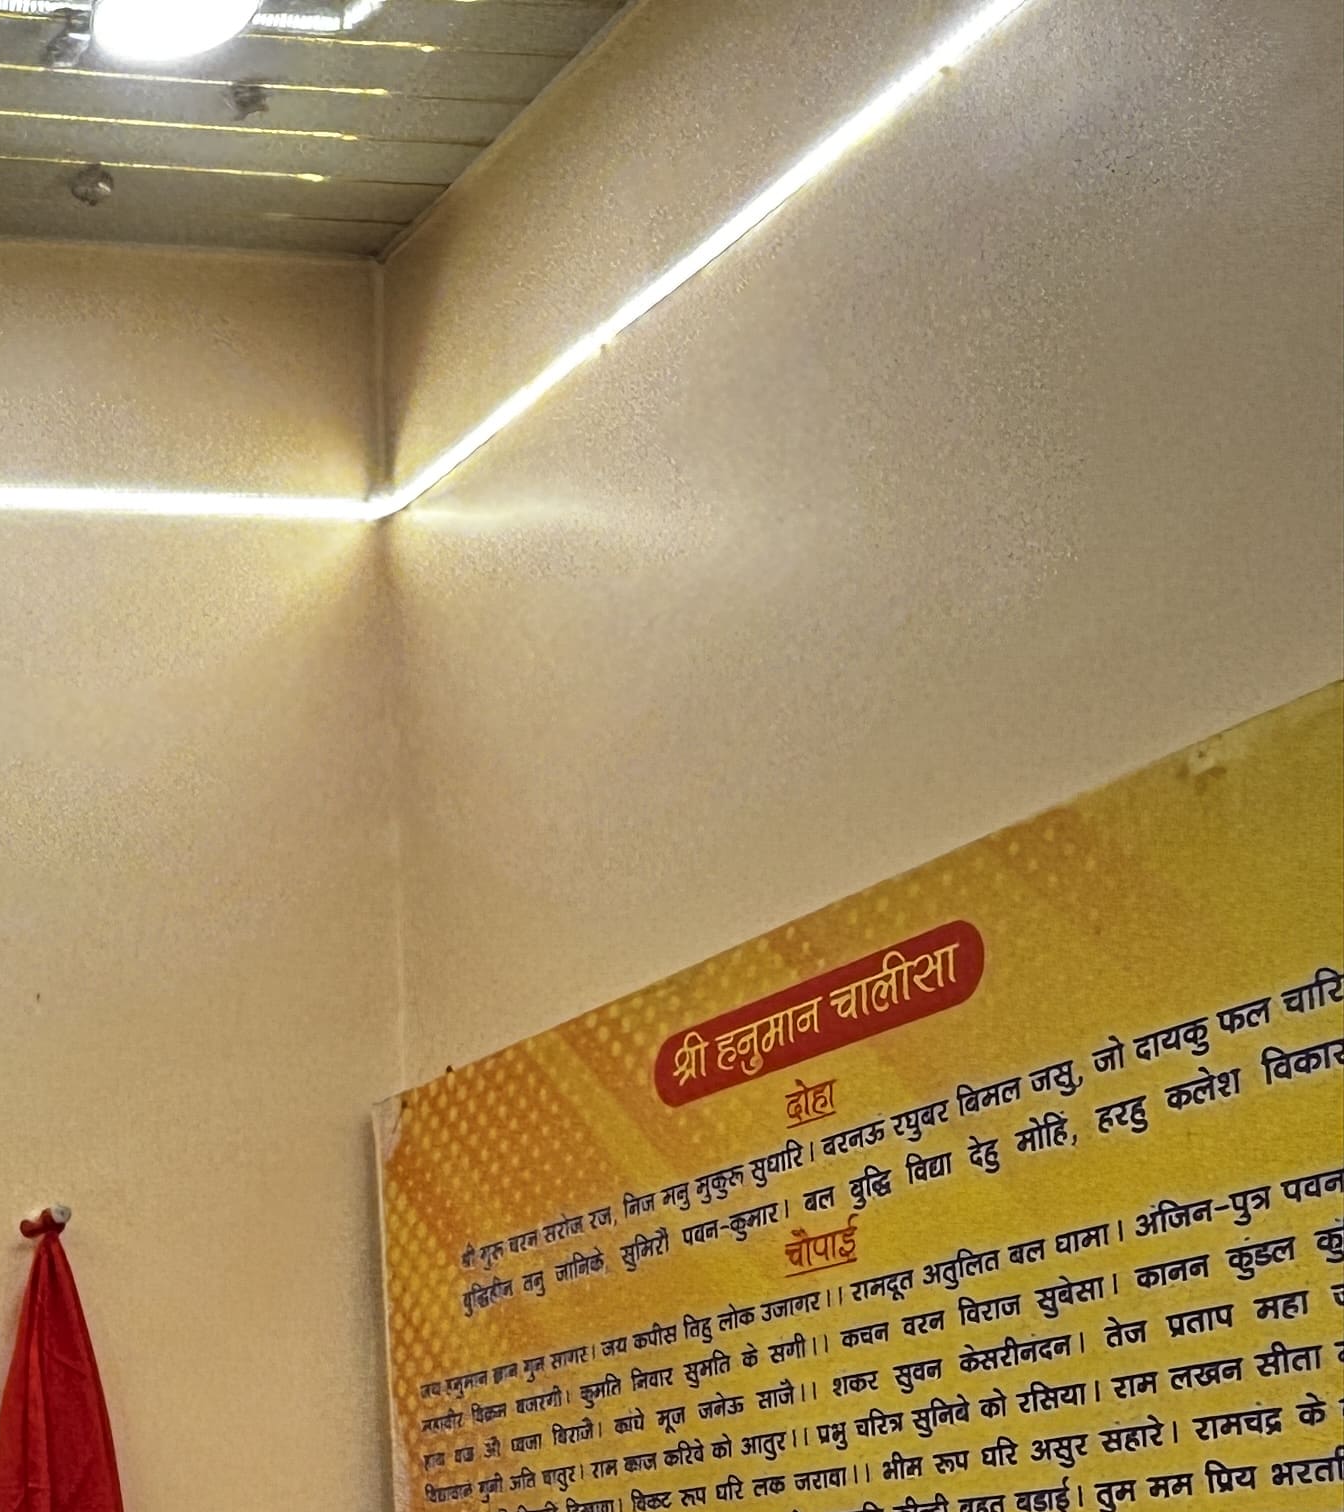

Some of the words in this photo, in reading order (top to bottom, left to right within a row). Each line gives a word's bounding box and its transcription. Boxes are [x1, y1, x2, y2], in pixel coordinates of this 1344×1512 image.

[672, 1031, 706, 1086] श्री
[714, 996, 821, 1075] हनुमान
[829, 943, 959, 1019] चालीसा
[1091, 1034, 1125, 1073] जो
[1132, 1016, 1210, 1061] दायकु
[1215, 996, 1272, 1034] फल
[783, 1077, 836, 1120] दोहा
[966, 1134, 1001, 1174] देहु
[1094, 1094, 1149, 1134] हरहु
[1163, 1065, 1242, 1110] कलेश
[784, 1212, 858, 1267] चौपाई
[716, 1302, 756, 1332] लोक
[922, 1247, 1001, 1291] अतुलित
[1102, 1315, 1148, 1349] तेज
[1164, 1303, 1235, 1338] प्रताप
[1252, 1289, 1310, 1320] महा
[852, 1407, 904, 1437] चरित्र
[1110, 1370, 1159, 1399] राम
[1167, 1356, 1244, 1391] लखन
[1253, 1340, 1323, 1377] सीता
[1030, 1433, 1089, 1469] असुर
[1145, 1472, 1194, 1498] मम
[1204, 1459, 1258, 1494] प्रिय
